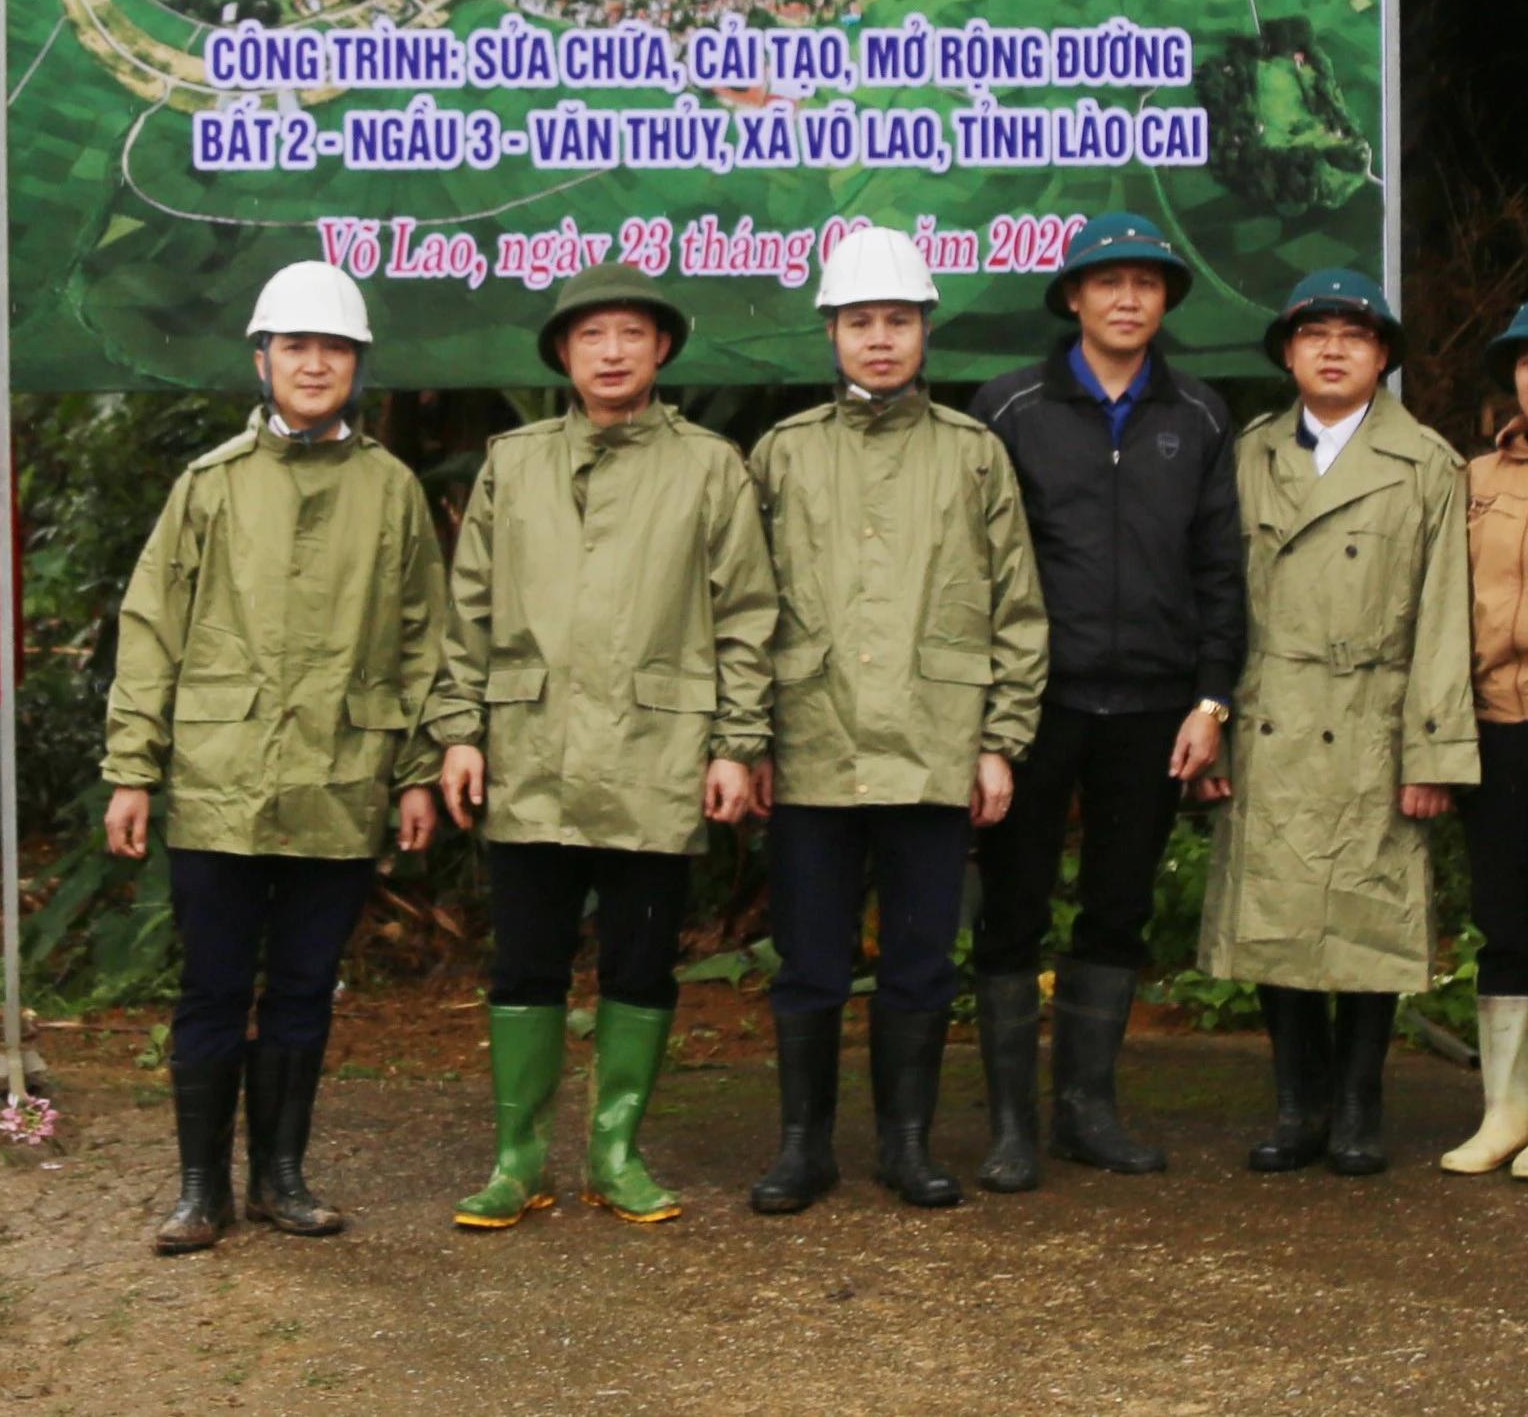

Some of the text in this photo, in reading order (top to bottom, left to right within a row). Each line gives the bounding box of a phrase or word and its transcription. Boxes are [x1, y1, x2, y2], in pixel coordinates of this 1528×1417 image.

[212, 19, 1186, 90] CÔNG TRÌNH: SỬA CHỮA, CẢI TẠO, MỞ RỘNG ĐƯỜNG
[200, 99, 1202, 166] BẤT 2 - NGẦU 3 - VĂN THỦY, XÃ VÕ LAO, TỈNH LÀO CAI
[323, 222, 378, 271] Võ
[393, 222, 485, 284] Lao,
[501, 222, 609, 285] ngày
[623, 223, 670, 271] 23
[683, 218, 813, 284] tháng
[821, 220, 869, 266] 0
[920, 219, 976, 269] ăm
